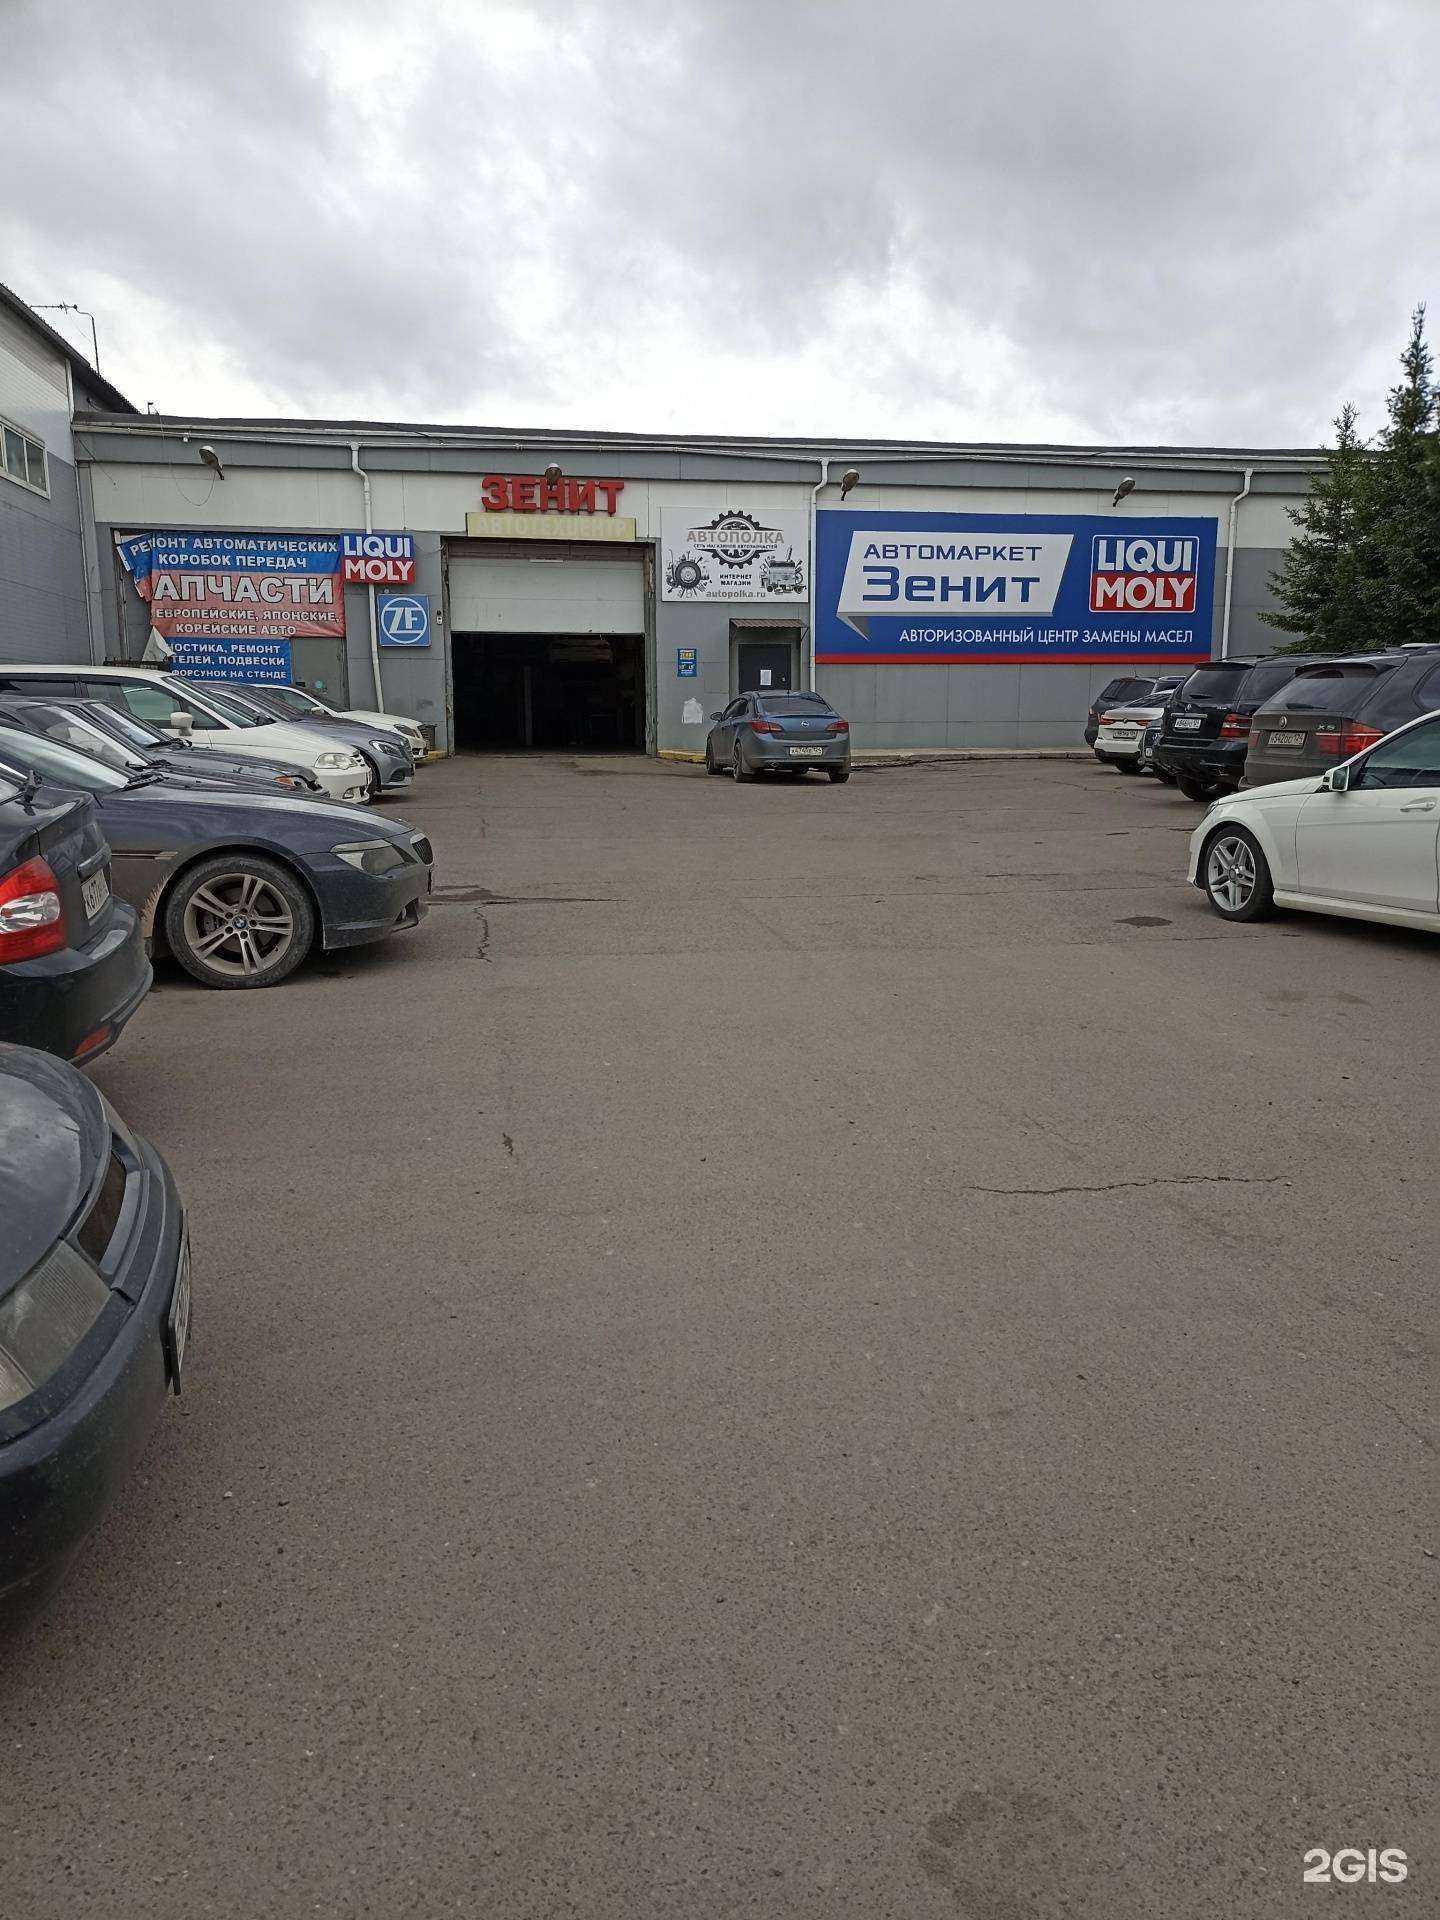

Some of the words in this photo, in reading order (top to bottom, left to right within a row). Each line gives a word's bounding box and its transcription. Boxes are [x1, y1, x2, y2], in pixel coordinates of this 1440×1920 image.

[481, 476, 625, 515] ЗЕНИТ
[193, 538, 339, 553] АВТОМАТИЧЕСКИХ
[686, 530, 785, 544] АВТОПОЛКА
[343, 535, 411, 558] LIQUI
[863, 543, 1043, 561] АВТОМАРКЕТ
[158, 553, 231, 566] КОРОБОК
[236, 555, 307, 570] ПЕРЕДАЧ
[1096, 539, 1192, 574] LIQUI
[344, 559, 414, 581] MOLY
[153, 574, 334, 604] АПЧАСТИ
[862, 565, 1041, 603] Зенит
[1095, 575, 1195, 609] MOLY
[706, 590, 766, 599] autopolka.ru
[156, 608, 259, 621] ЕВРОПЕЙСКИЕ,
[262, 610, 340, 623] ЯПОНСКИЕ,
[383, 607, 424, 633] ZF
[175, 622, 257, 635] КОРЕЙСКИЕ
[261, 625, 297, 635] АВТО
[899, 627, 1034, 643] АВТОРИЗОВАННЫЙ
[1037, 630, 1079, 645] ЦЕНТР
[1081, 630, 1141, 643] ЗАМЕНЫ
[1144, 630, 1193, 643] МАСЕЛ
[231, 644, 281, 654] РЕМОНТ
[218, 656, 285, 666] ПОДВЕСКИ
[230, 670, 244, 678] НА
[247, 671, 287, 679] СТЕНДЕ
